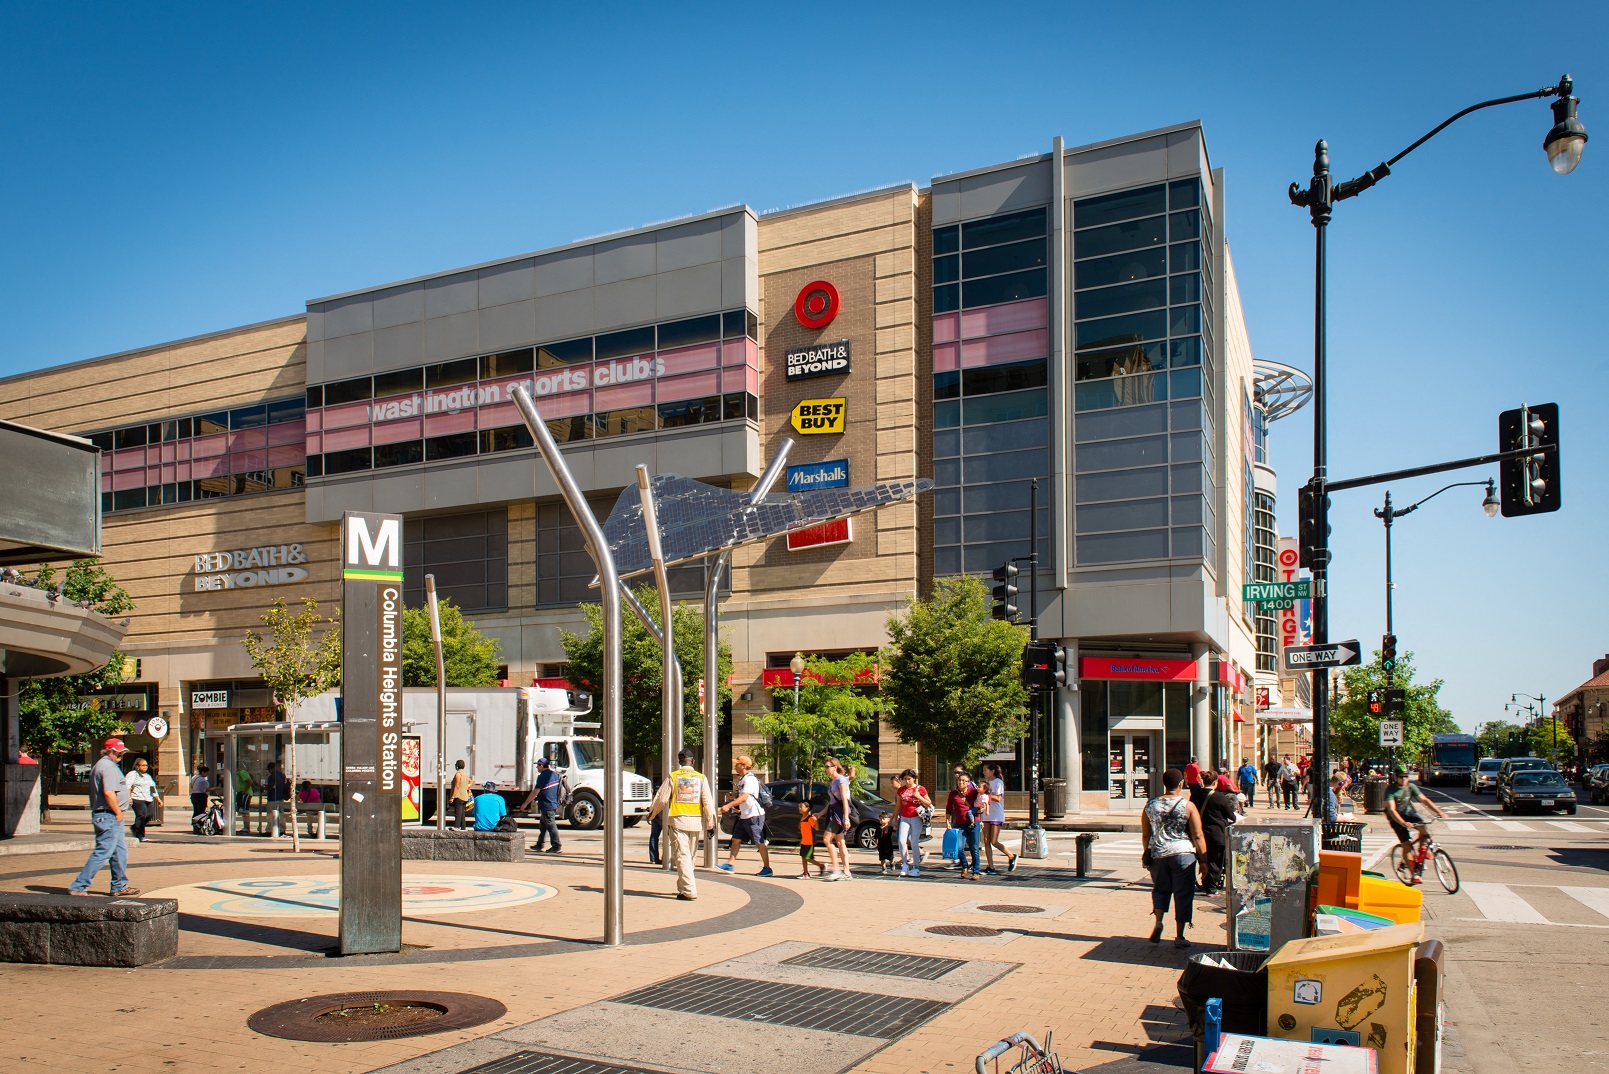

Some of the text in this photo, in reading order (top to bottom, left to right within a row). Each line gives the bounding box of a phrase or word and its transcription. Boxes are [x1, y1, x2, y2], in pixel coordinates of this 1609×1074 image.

[787, 359, 848, 376] BEYOND
[367, 385, 500, 422] washington
[594, 356, 666, 386] clubs
[799, 404, 844, 416] BEST
[801, 417, 839, 429] BUY
[789, 467, 847, 486] Marshalls
[348, 516, 399, 567] M
[194, 567, 309, 592] BEYOND
[1246, 584, 1296, 599] IRVING
[1261, 599, 1292, 610] 1400
[1292, 650, 1337, 663] ONE WAY
[1110, 664, 1127, 673] Bank
[1134, 665, 1160, 674] America
[380, 588, 398, 790] Columbia Heights Station
[193, 692, 227, 703] ZOMBIE
